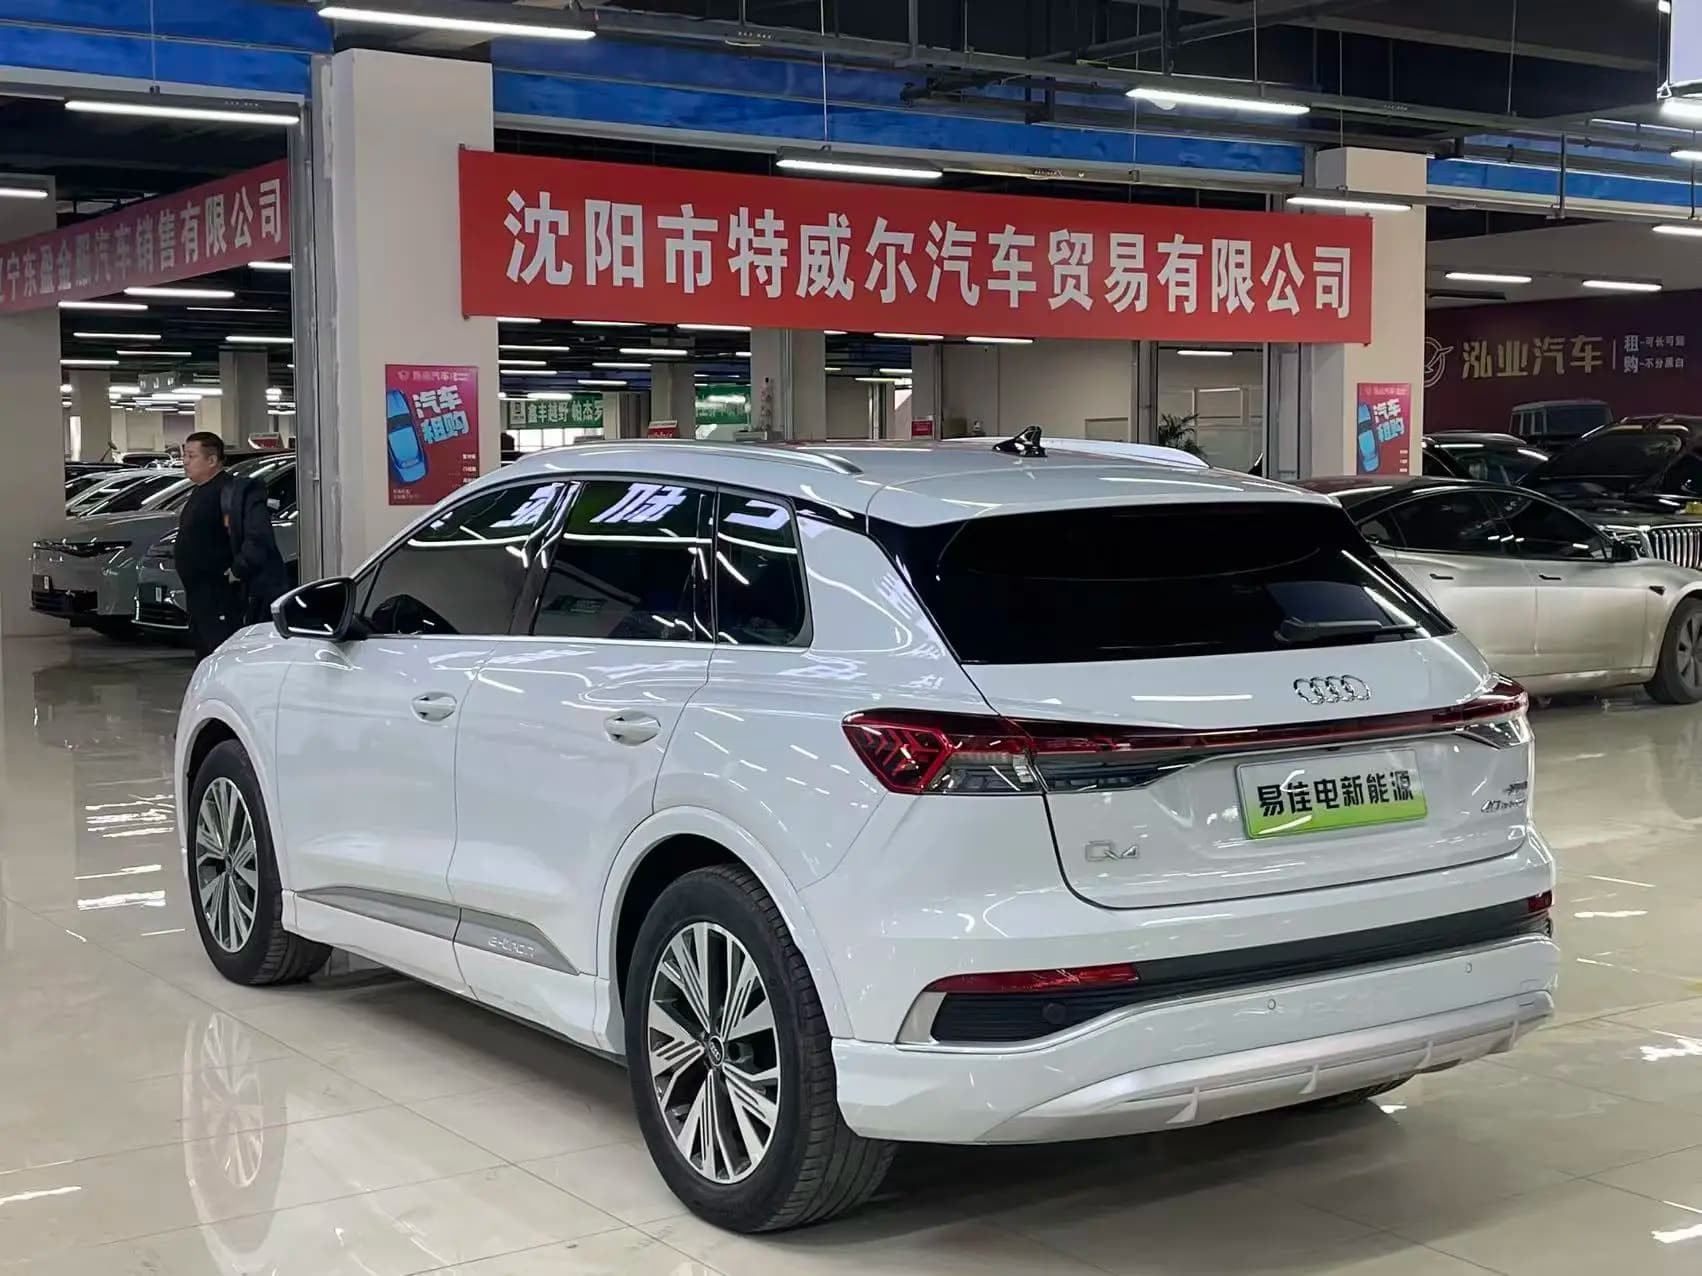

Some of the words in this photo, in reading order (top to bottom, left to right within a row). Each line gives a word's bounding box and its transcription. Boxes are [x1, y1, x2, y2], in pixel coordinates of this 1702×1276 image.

[503, 189, 1351, 319] 沈阳市特威尔汽车贸易有限公司
[1461, 334, 1604, 379] 泓业汽车
[412, 384, 463, 419] 汽车
[1257, 770, 1414, 817] 易佳电新能源
[1085, 841, 1139, 862] Q4
